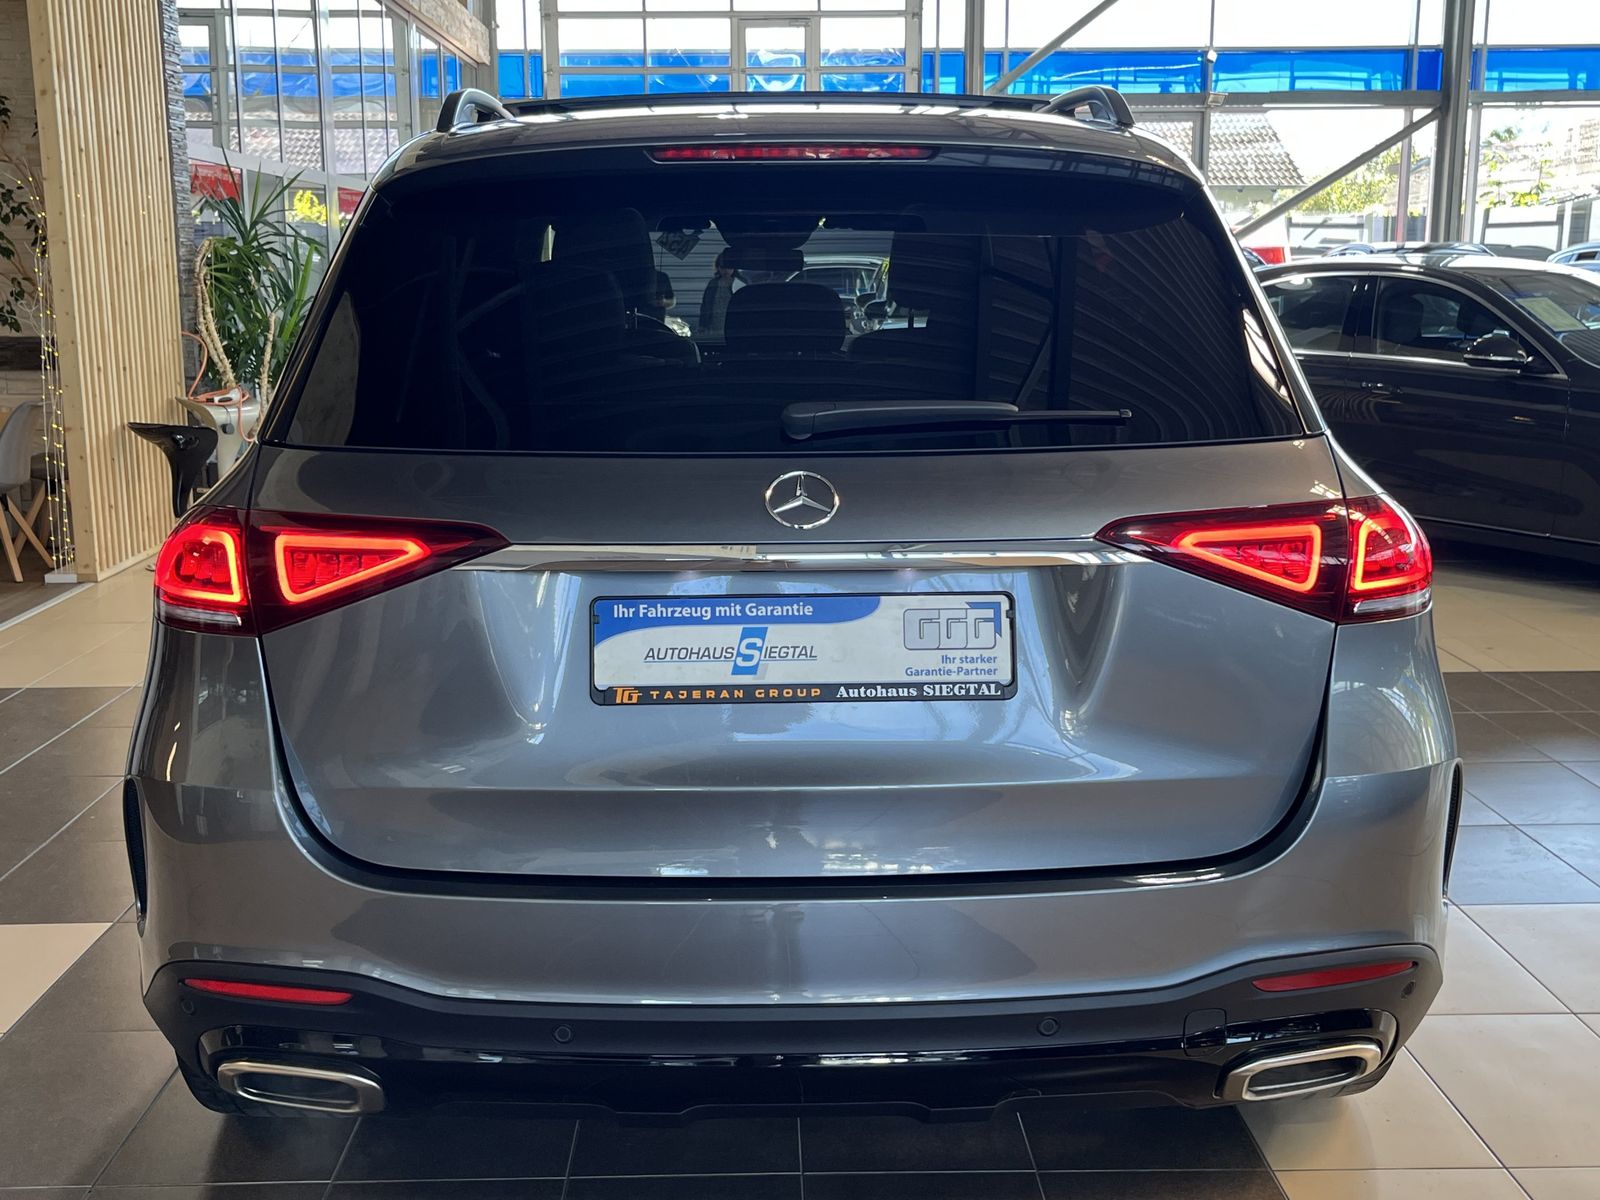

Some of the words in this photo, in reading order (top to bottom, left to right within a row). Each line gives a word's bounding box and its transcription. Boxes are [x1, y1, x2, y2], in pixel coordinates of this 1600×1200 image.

[613, 604, 635, 618] Ihr
[639, 603, 712, 620] Fahrzeug
[715, 603, 742, 617] mit
[745, 602, 814, 617] Garantie
[644, 646, 735, 661] AUTOHAUS
[941, 654, 957, 665] Ihr
[959, 653, 998, 665] starker
[904, 666, 998, 677] Garantie-Partner
[650, 688, 745, 700] TAJERAN
[754, 687, 822, 698] GROUP
[836, 685, 918, 699] Autohaus
[923, 683, 1001, 697] SIEGTAL
